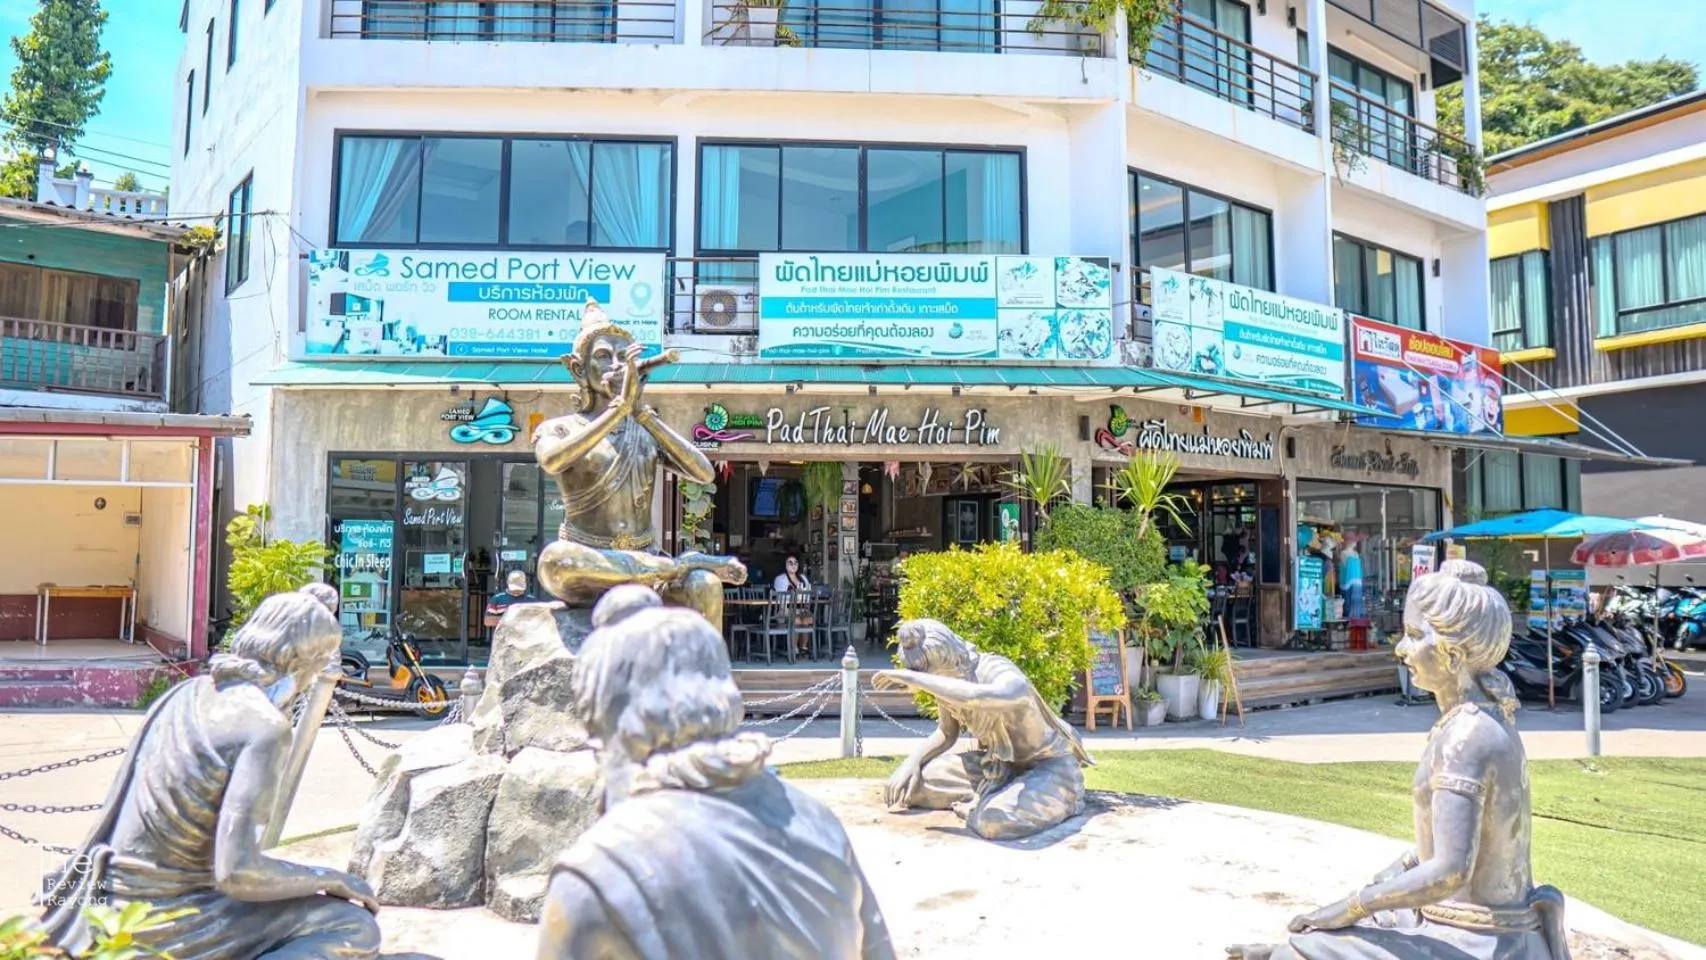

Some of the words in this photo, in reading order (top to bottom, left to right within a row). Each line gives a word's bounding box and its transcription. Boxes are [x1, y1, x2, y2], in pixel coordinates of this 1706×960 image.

[401, 256, 497, 280] Samed
[507, 257, 560, 280] Port
[569, 258, 636, 280] View
[775, 256, 988, 283] ผัดไทยแม่หอยพิมพ์
[489, 308, 533, 321] ROOM
[537, 308, 582, 321] RENTAL
[1229, 289, 1338, 331] ผัดไทยแม่หอยพิมพ์
[766, 407, 804, 445] Pad
[810, 406, 856, 445] Thai
[862, 408, 908, 445] Mae
[918, 408, 952, 445] Hoi
[965, 408, 1000, 445] Pim
